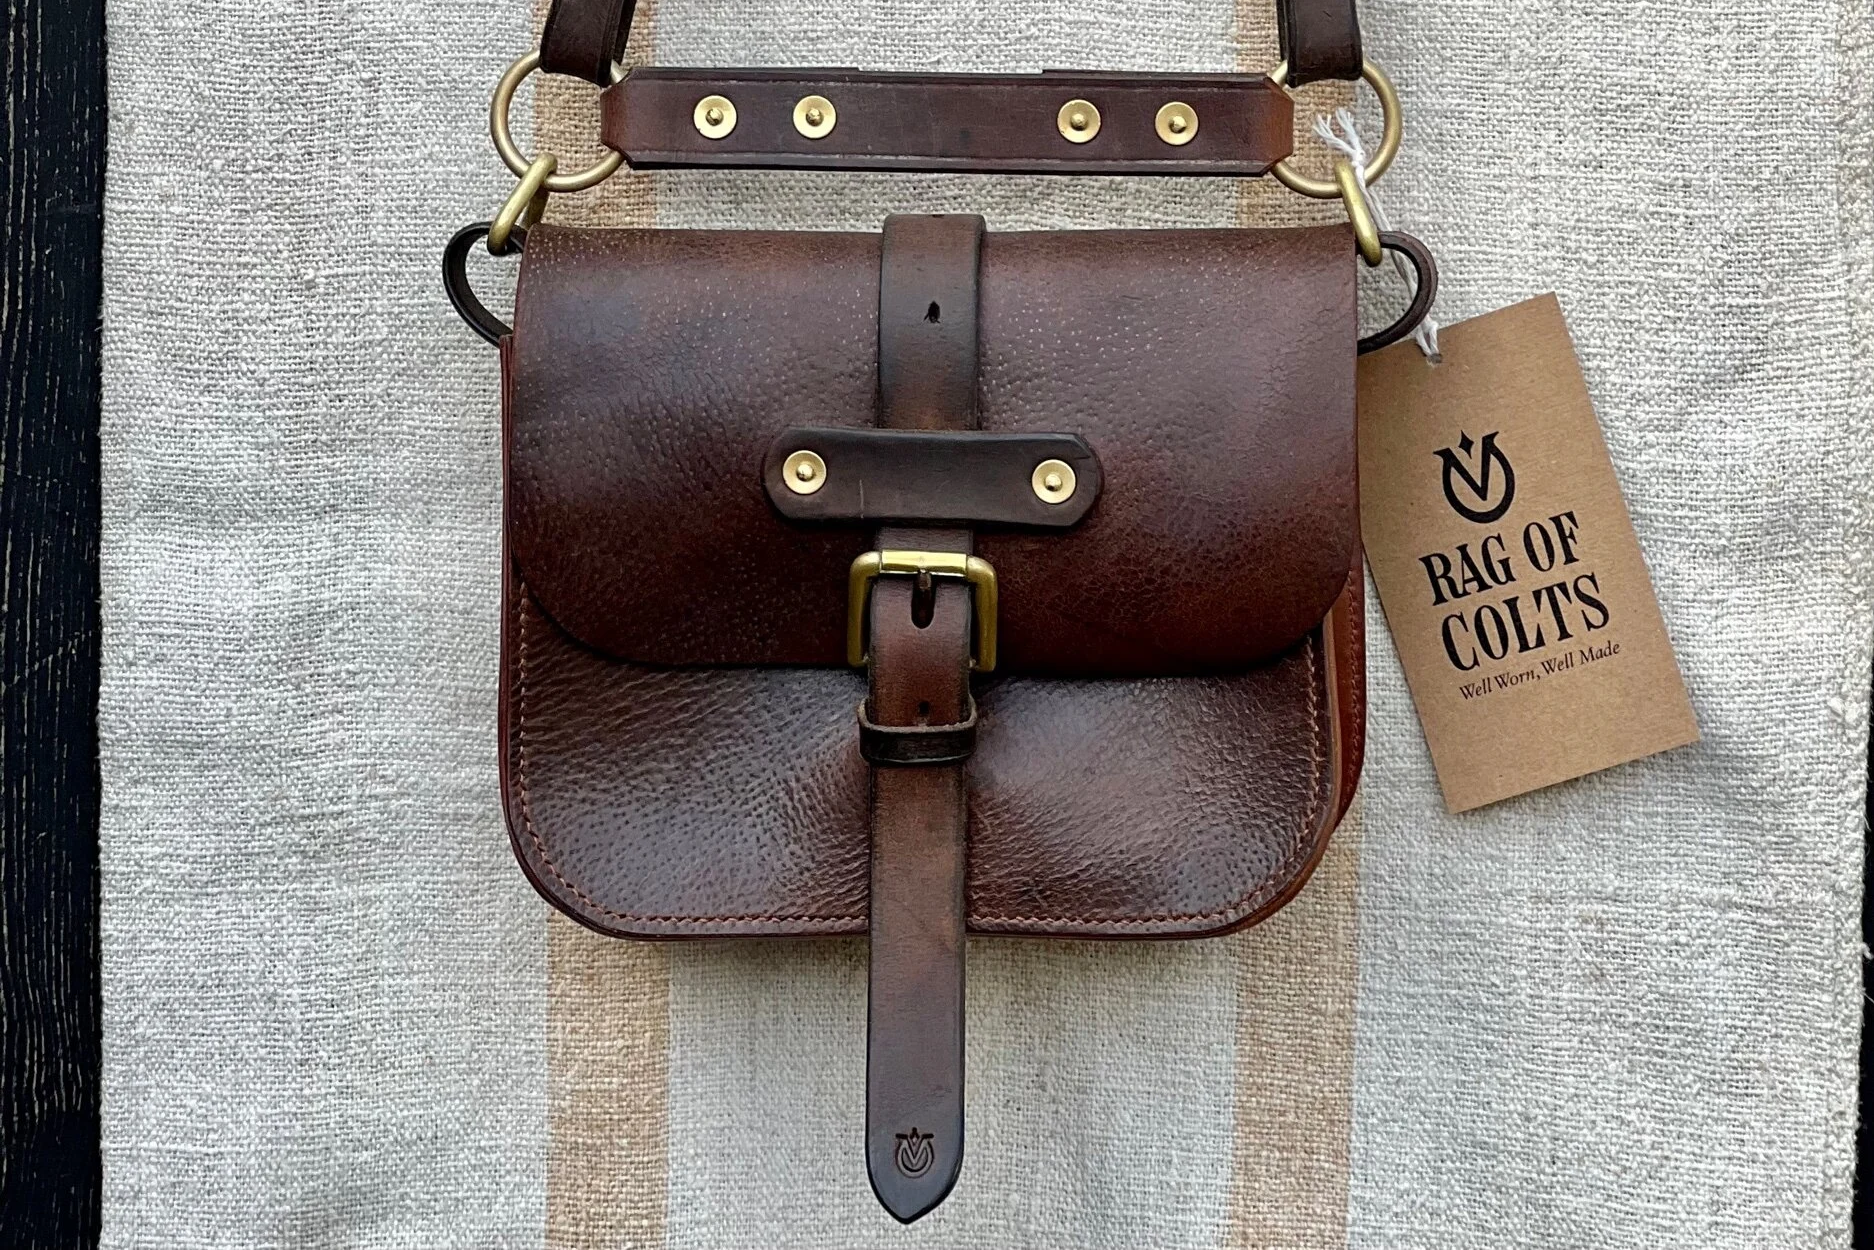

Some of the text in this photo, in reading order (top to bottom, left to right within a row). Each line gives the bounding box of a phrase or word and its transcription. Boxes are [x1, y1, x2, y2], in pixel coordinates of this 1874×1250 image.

[1419, 511, 1580, 606] RAG OF
[1441, 573, 1610, 671] COLTS
[1459, 640, 1620, 700] Well Worn, Well Made
